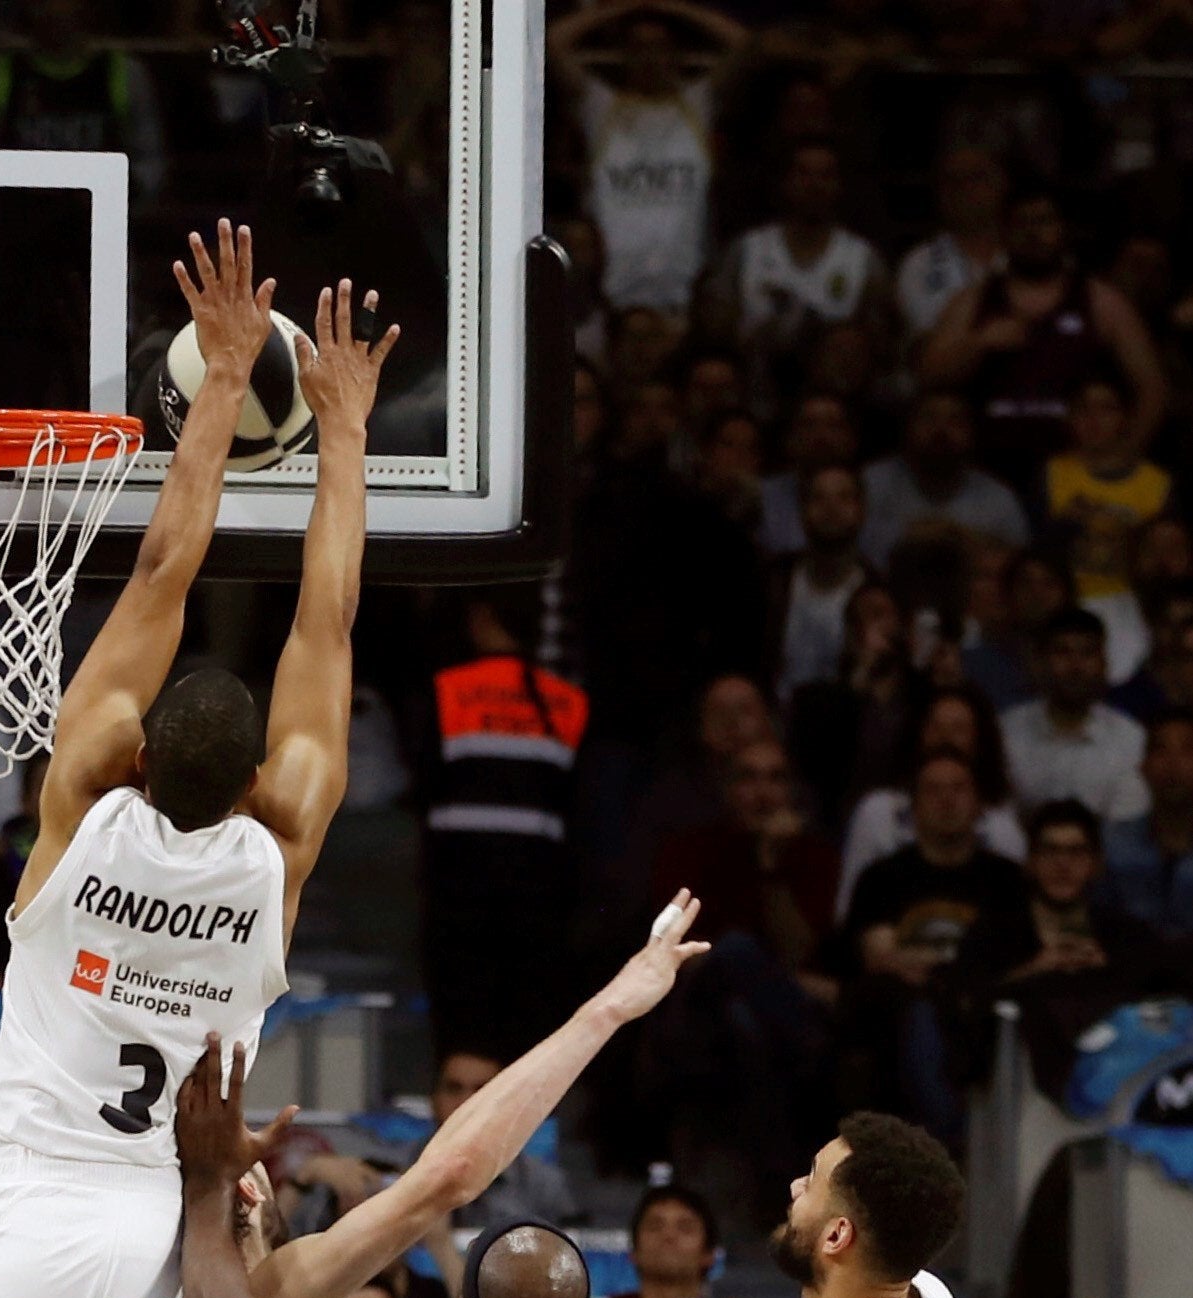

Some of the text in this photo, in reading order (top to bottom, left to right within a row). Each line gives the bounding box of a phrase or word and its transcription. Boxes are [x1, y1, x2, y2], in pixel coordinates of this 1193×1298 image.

[74, 874, 258, 944] RANDOLPH
[110, 985, 192, 1017] Europea
[115, 963, 233, 1003] Universidad
[98, 1043, 167, 1134] 3
